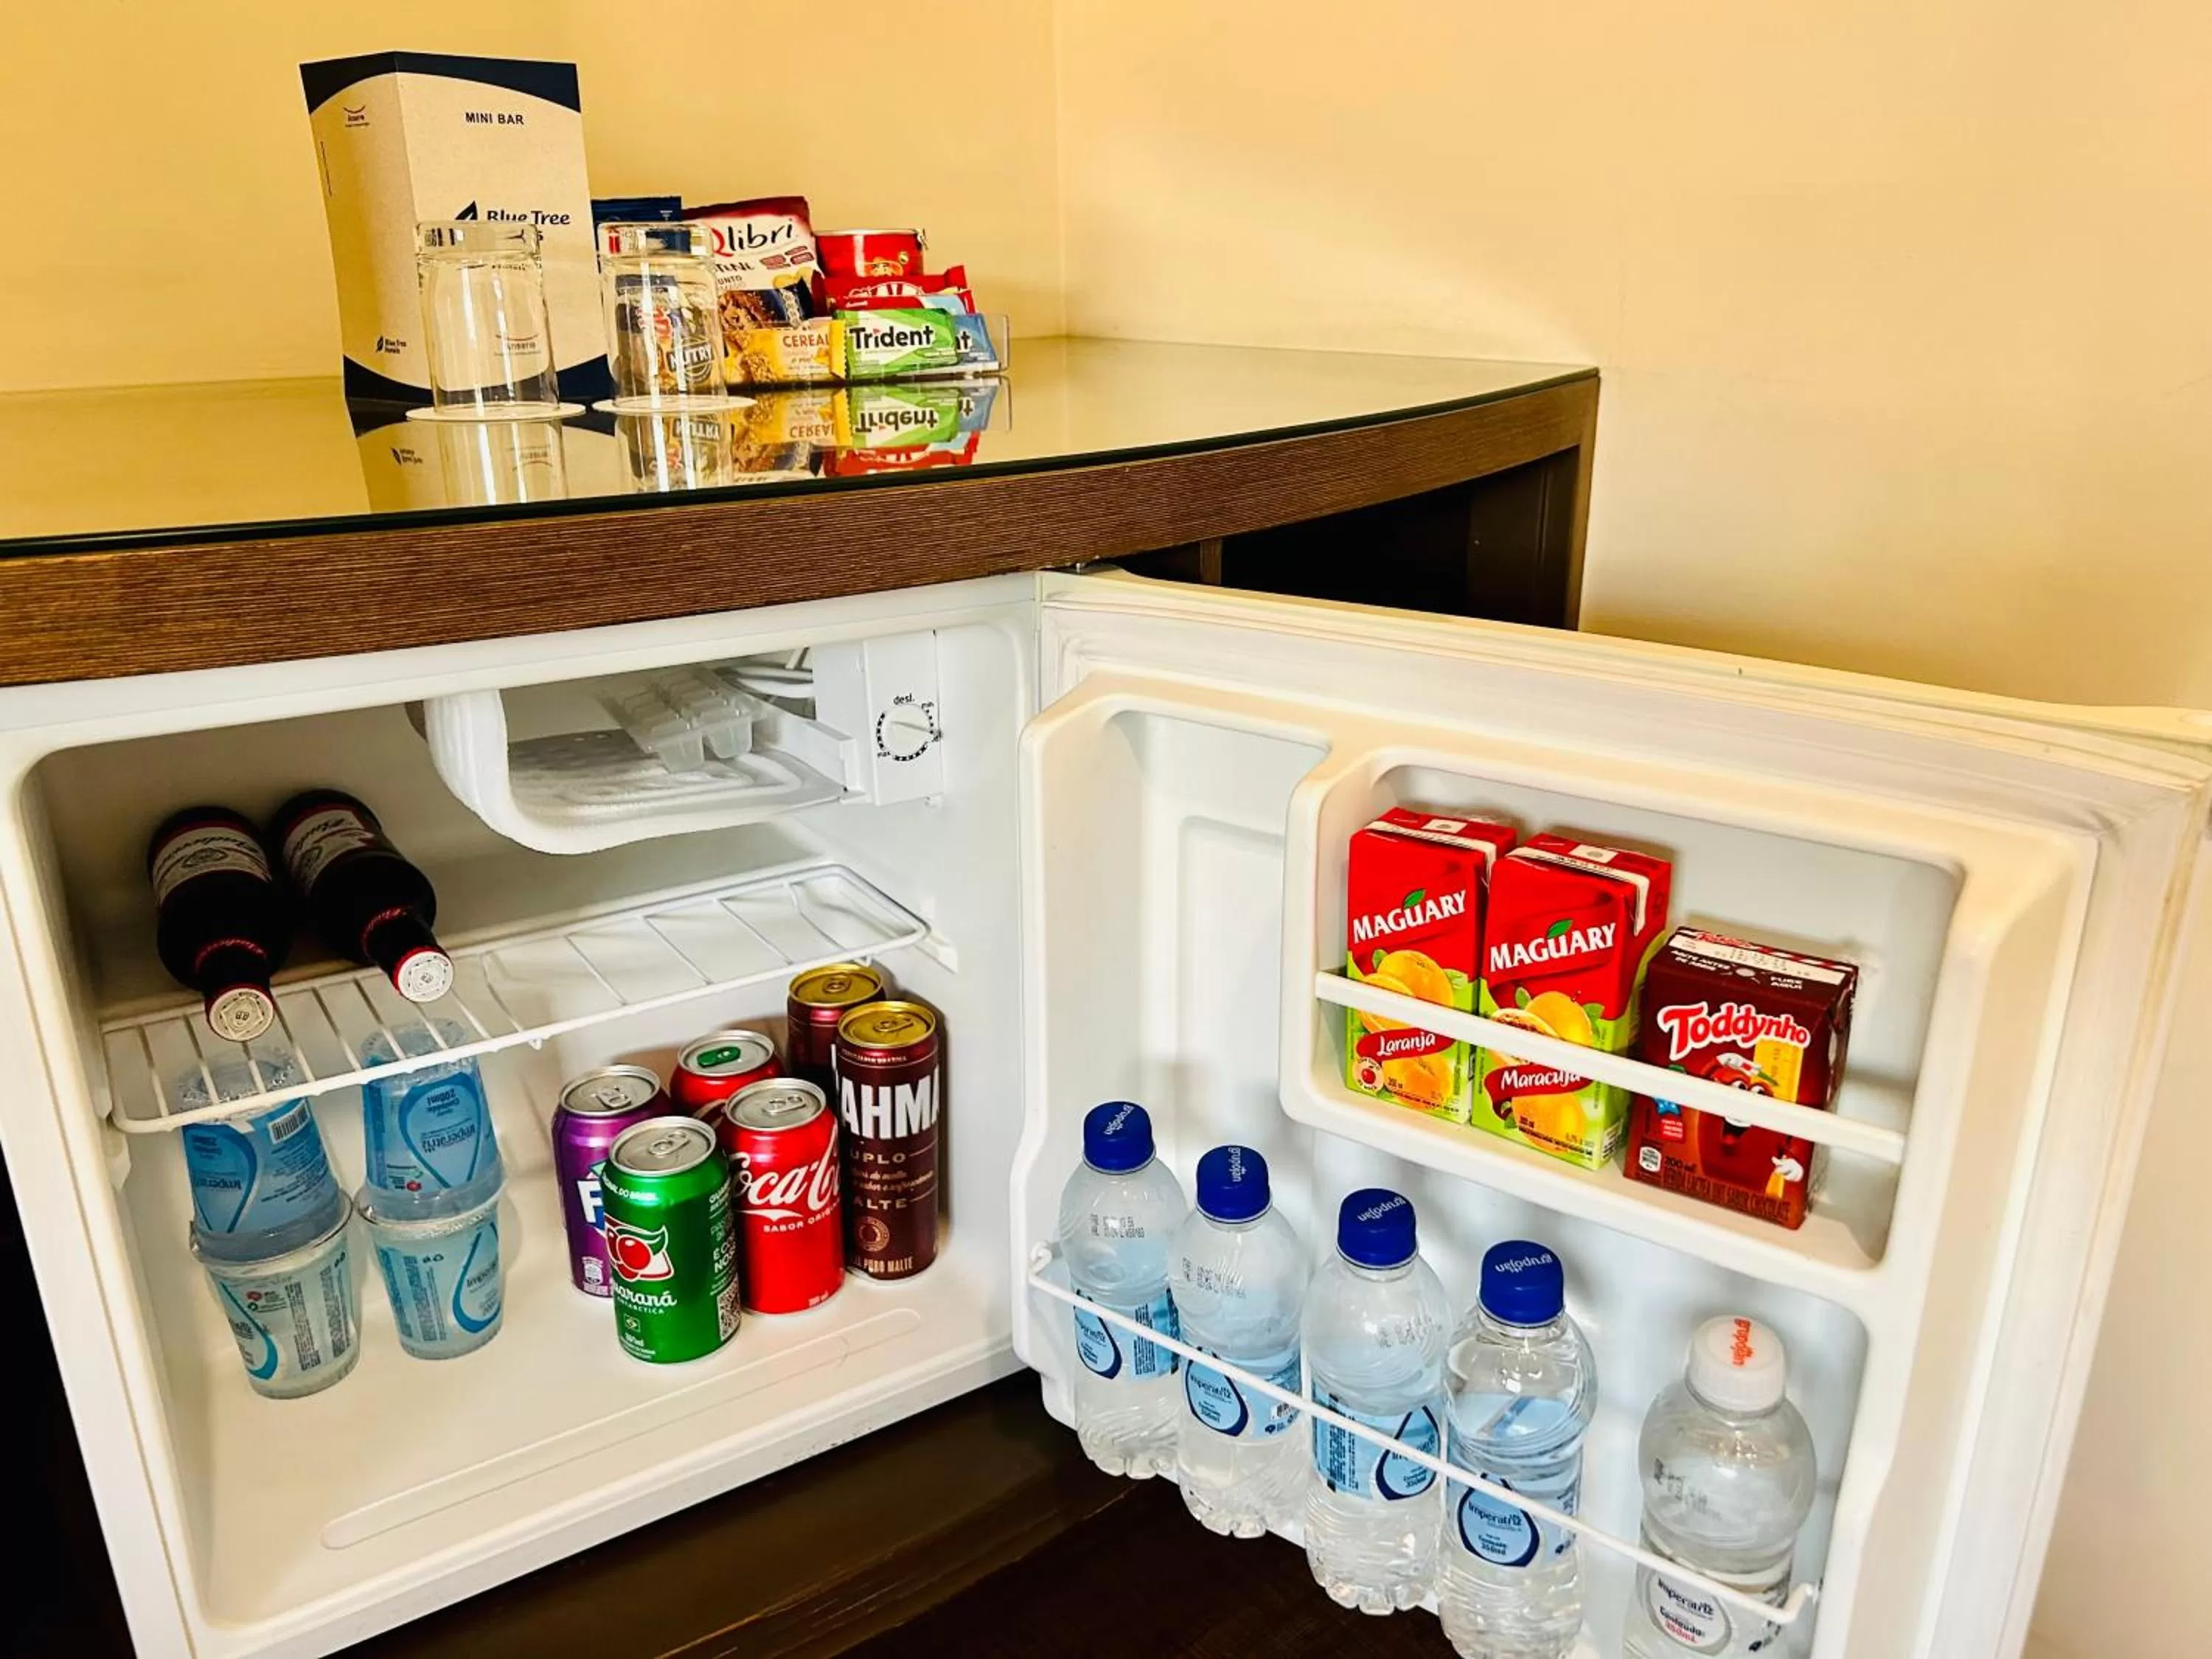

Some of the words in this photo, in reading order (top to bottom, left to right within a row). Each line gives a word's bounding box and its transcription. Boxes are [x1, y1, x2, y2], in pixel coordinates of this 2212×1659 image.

[465, 112, 493, 124] MINI
[498, 114, 524, 125] BAR
[531, 211, 571, 225] Tree
[849, 326, 933, 349] Trident
[1352, 889, 1467, 944] MAGUARY
[1489, 922, 1617, 973] MAGUARY
[1659, 1003, 1810, 1060] Toddynho
[1377, 1031, 1436, 1057] Laranja
[763, 1221, 804, 1233] SABOR
